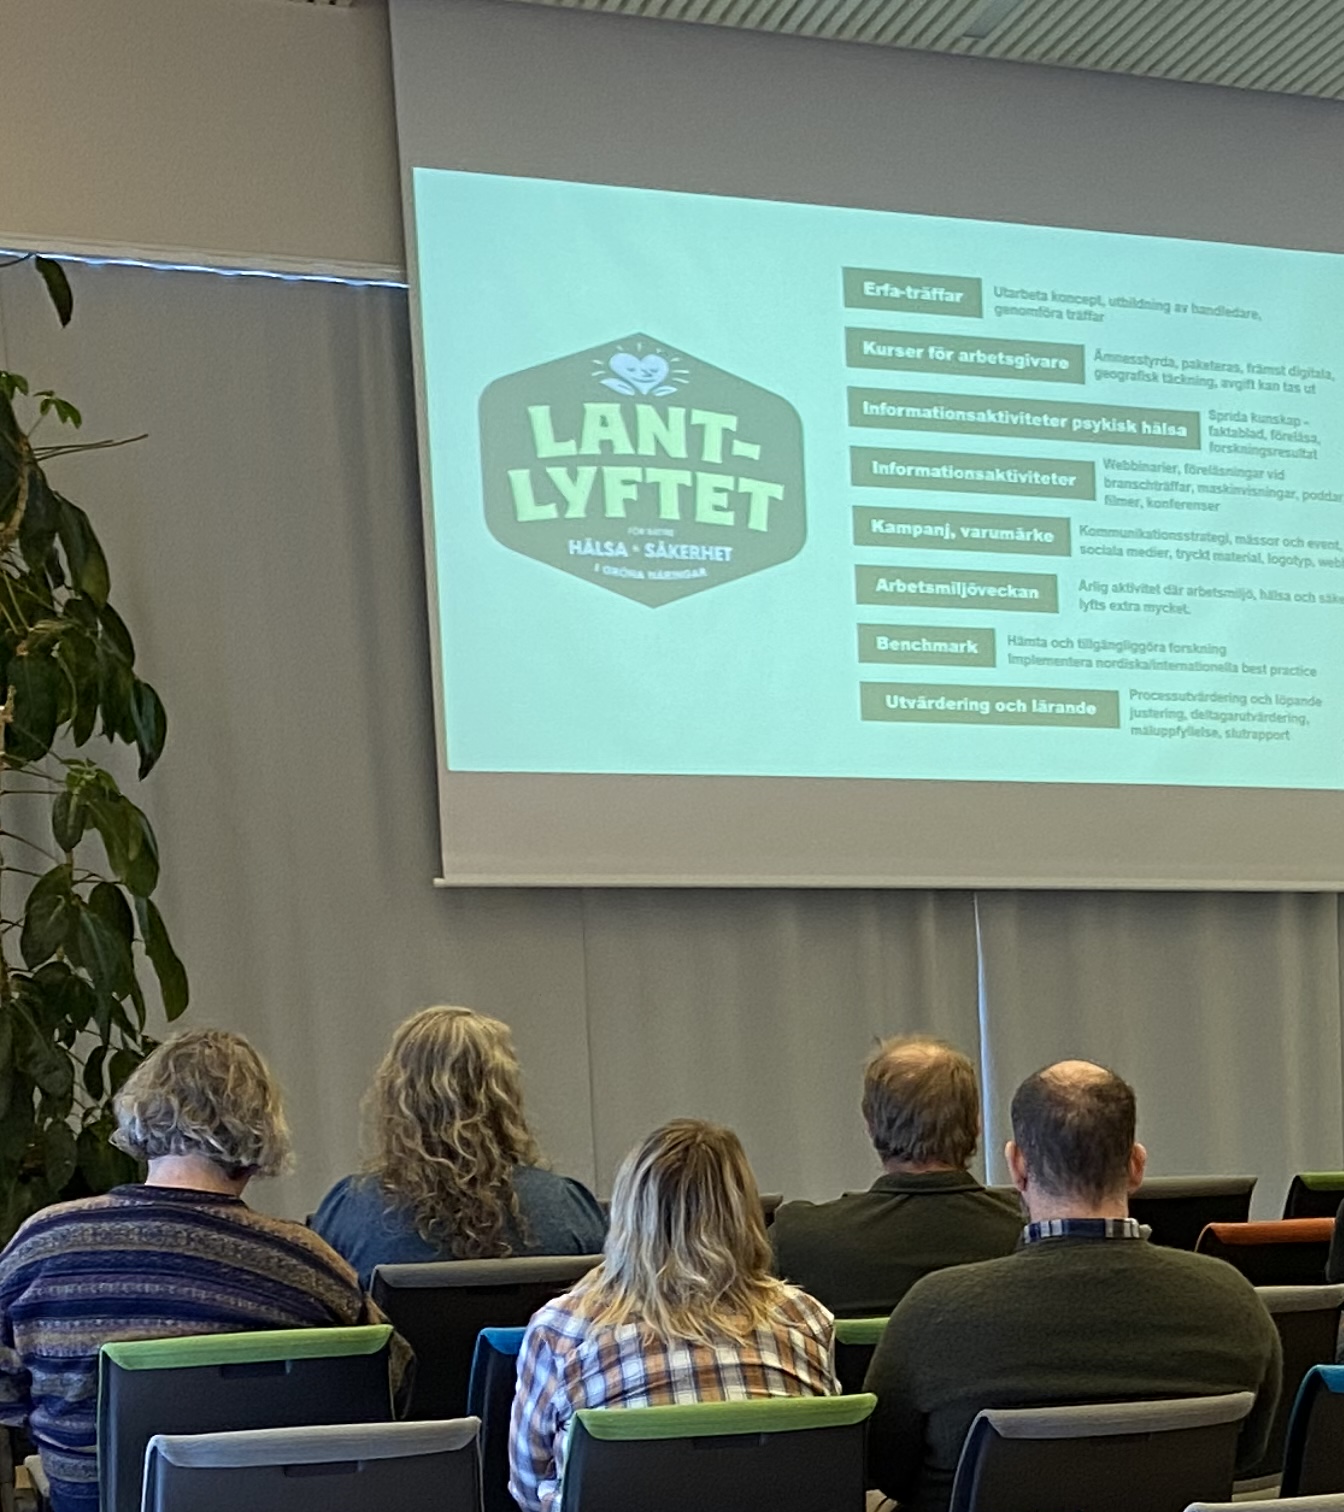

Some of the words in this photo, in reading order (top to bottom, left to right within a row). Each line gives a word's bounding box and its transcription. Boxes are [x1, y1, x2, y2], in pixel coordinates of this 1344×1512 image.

[863, 281, 964, 302] Erfa-träffar
[993, 286, 1048, 300] Utarbeta
[1174, 303, 1188, 313] av
[863, 341, 923, 359] Kurser
[928, 346, 954, 361] för
[958, 349, 1069, 370] arbetsgivare
[1094, 368, 1158, 383] geografisk
[1221, 379, 1255, 392] avgift
[1258, 380, 1279, 392] kan
[1283, 382, 1300, 393] tas
[1304, 383, 1316, 394] ut
[863, 400, 1068, 428] Informationsaktiviteter
[1072, 414, 1138, 434] psykisk
[1141, 420, 1188, 437] hälsa
[1209, 409, 1247, 424] Sprida
[1251, 412, 1300, 428] kunskap
[527, 402, 761, 463] LANT-
[872, 460, 1076, 487] Informationsaktiviteter
[1267, 468, 1285, 481] vid
[507, 466, 784, 532] LYFTET
[871, 519, 956, 540] Kampanj,
[960, 525, 1054, 543] varumärke
[1080, 545, 1123, 557] sociala
[1283, 536, 1304, 548] och
[875, 578, 1039, 599] Arbetsmiljöveckan
[1294, 591, 1315, 603] och
[1078, 599, 1106, 612] lyfts
[1109, 600, 1140, 612] extra
[876, 636, 978, 654] Benchmark
[1007, 634, 1047, 648] Hämta
[1051, 637, 1074, 649] och
[1168, 642, 1227, 656] forskning
[1008, 653, 1092, 668] Implementera
[1241, 663, 1267, 675] best
[1270, 665, 1317, 677] practice
[885, 695, 990, 714] Utvärdering
[995, 699, 1027, 713] och
[1032, 699, 1096, 715] lärande
[1250, 694, 1272, 706] och
[1275, 695, 1322, 707] löpande
